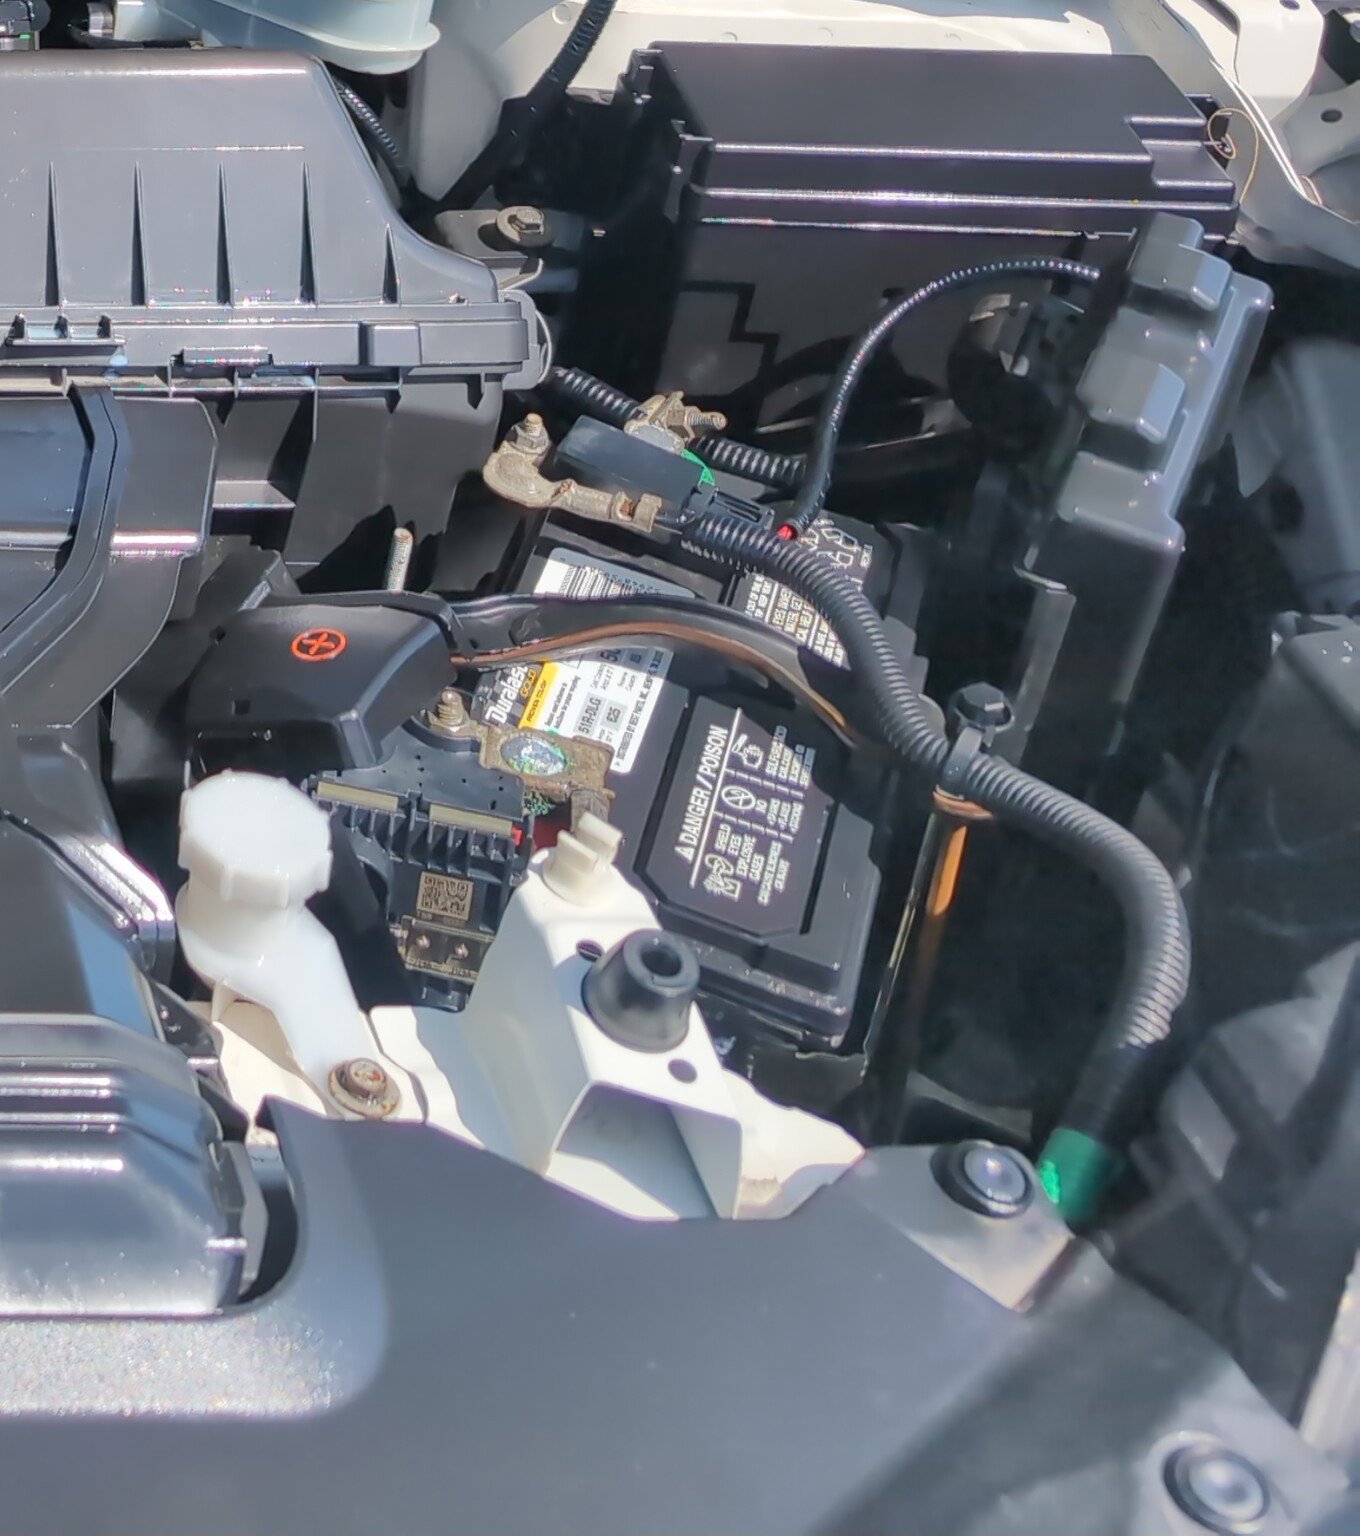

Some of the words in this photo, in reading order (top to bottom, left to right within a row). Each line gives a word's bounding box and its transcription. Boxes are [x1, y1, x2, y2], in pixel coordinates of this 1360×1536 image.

[485, 664, 528, 724] Duralast
[579, 696, 601, 734] 51R-DLG
[679, 786, 712, 847] DANGER
[698, 724, 729, 778] POISON
